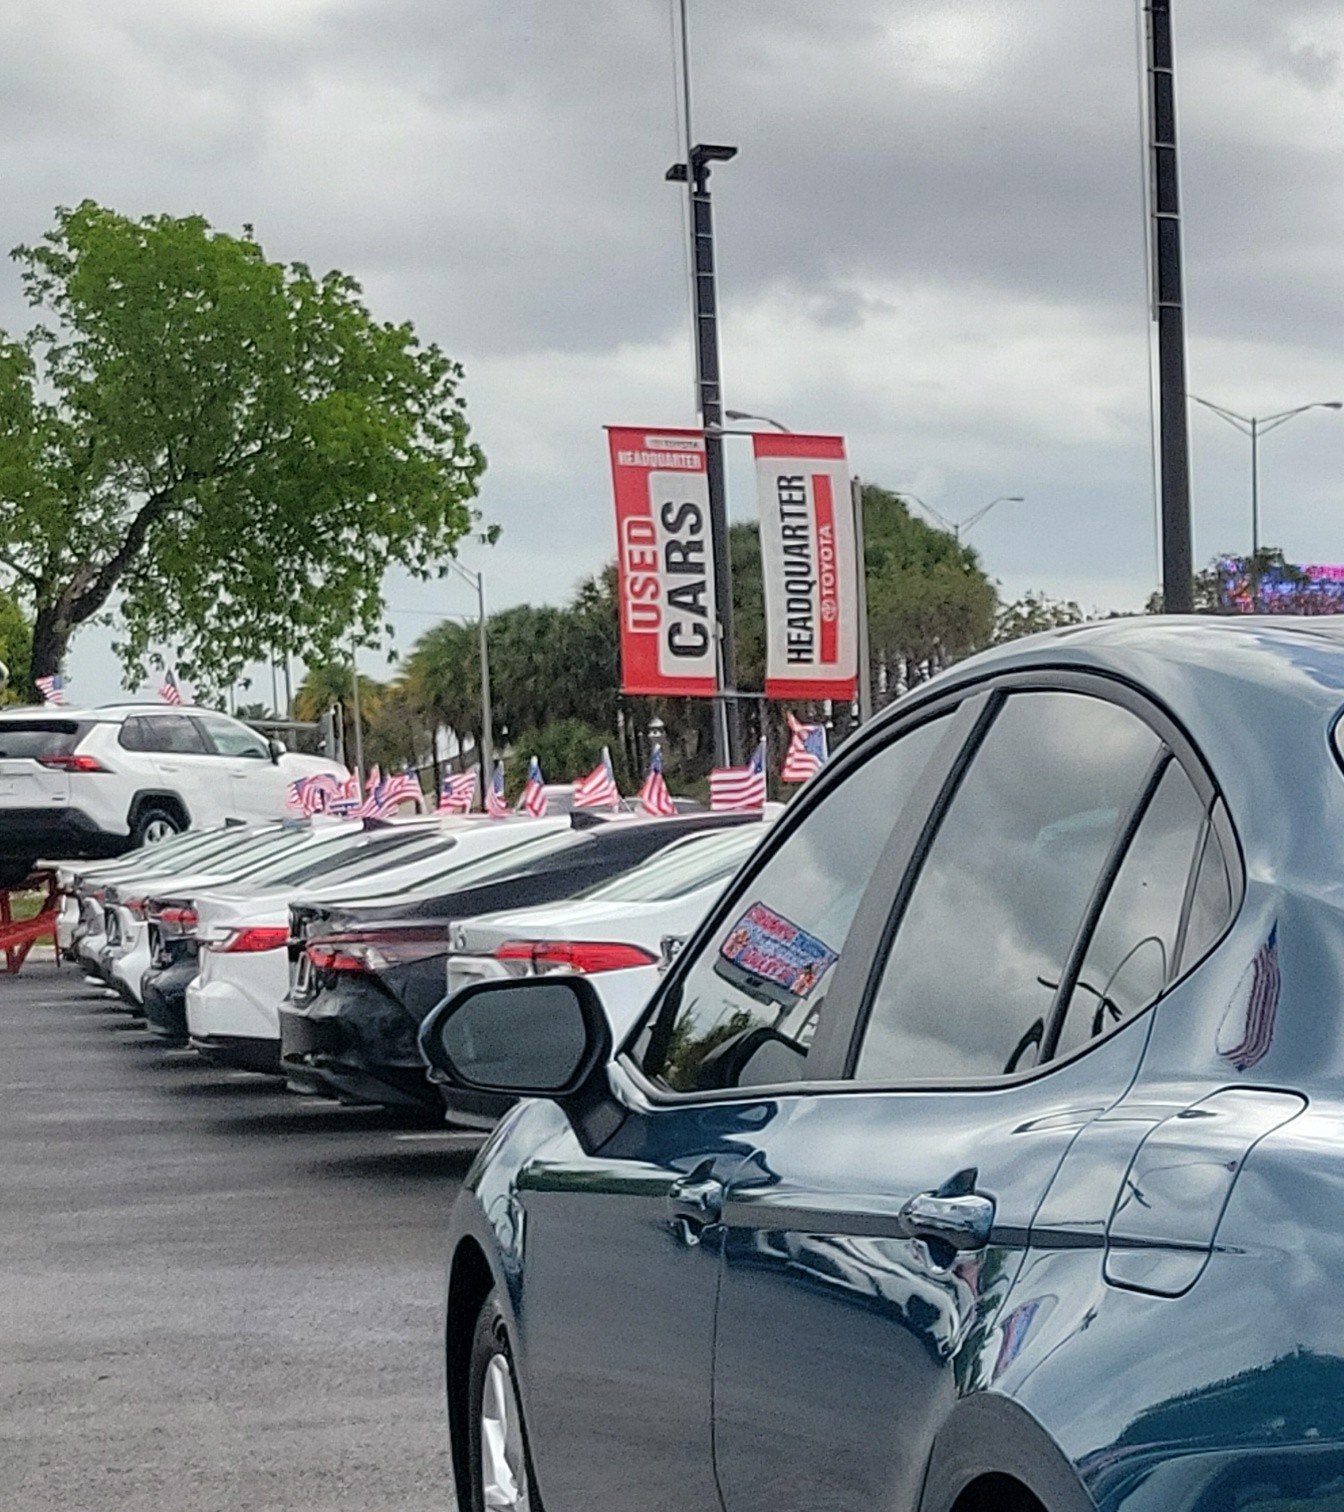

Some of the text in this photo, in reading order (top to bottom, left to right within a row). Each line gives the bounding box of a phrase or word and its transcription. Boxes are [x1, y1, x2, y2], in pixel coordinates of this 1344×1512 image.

[624, 517, 662, 632] USED
[660, 501, 710, 658] CARS
[776, 475, 817, 664] HEADQUARTER
[818, 524, 836, 599] TOYOTA
